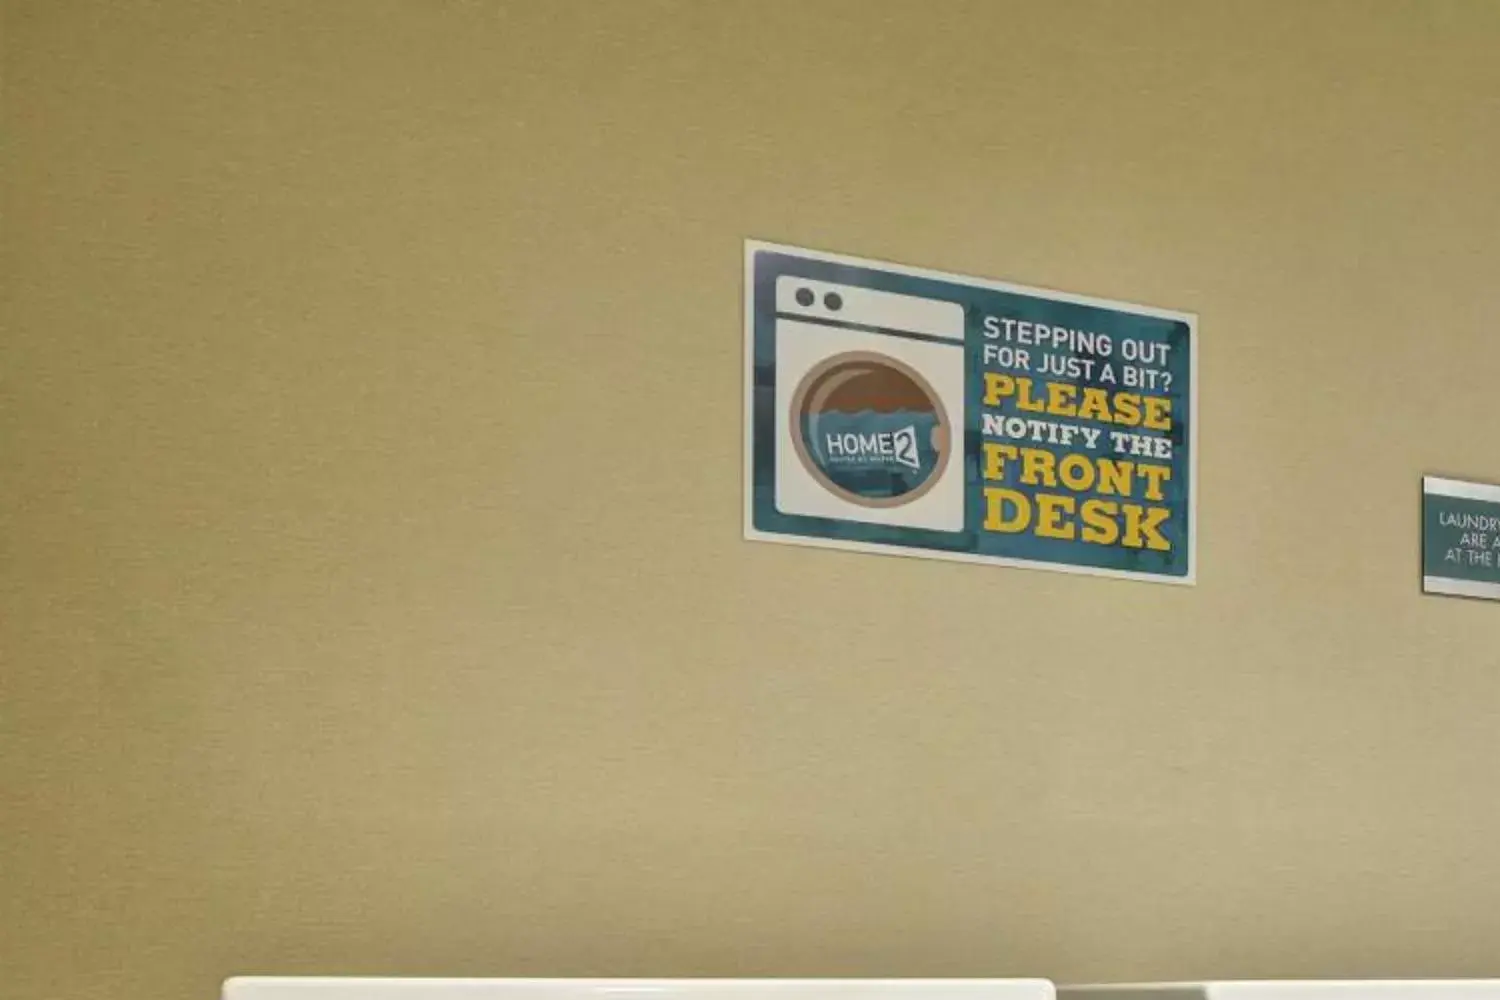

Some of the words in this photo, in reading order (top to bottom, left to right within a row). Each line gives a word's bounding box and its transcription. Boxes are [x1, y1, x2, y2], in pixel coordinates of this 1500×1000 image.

[984, 316, 1112, 356] STEPPING
[1121, 339, 1171, 366] OUT
[984, 344, 1030, 370] FOR
[1036, 353, 1094, 380] JUST
[1100, 363, 1116, 384] A
[1123, 366, 1172, 392] BIT?
[983, 372, 1171, 430] PLEASE
[982, 414, 1100, 448] NOTIFY
[1110, 431, 1172, 459] THE
[983, 442, 1171, 501] FRONT
[983, 487, 1171, 551] DESK
[1460, 533, 1487, 549] ARE
[1445, 549, 1461, 562] AT
[1467, 550, 1492, 567] THE
